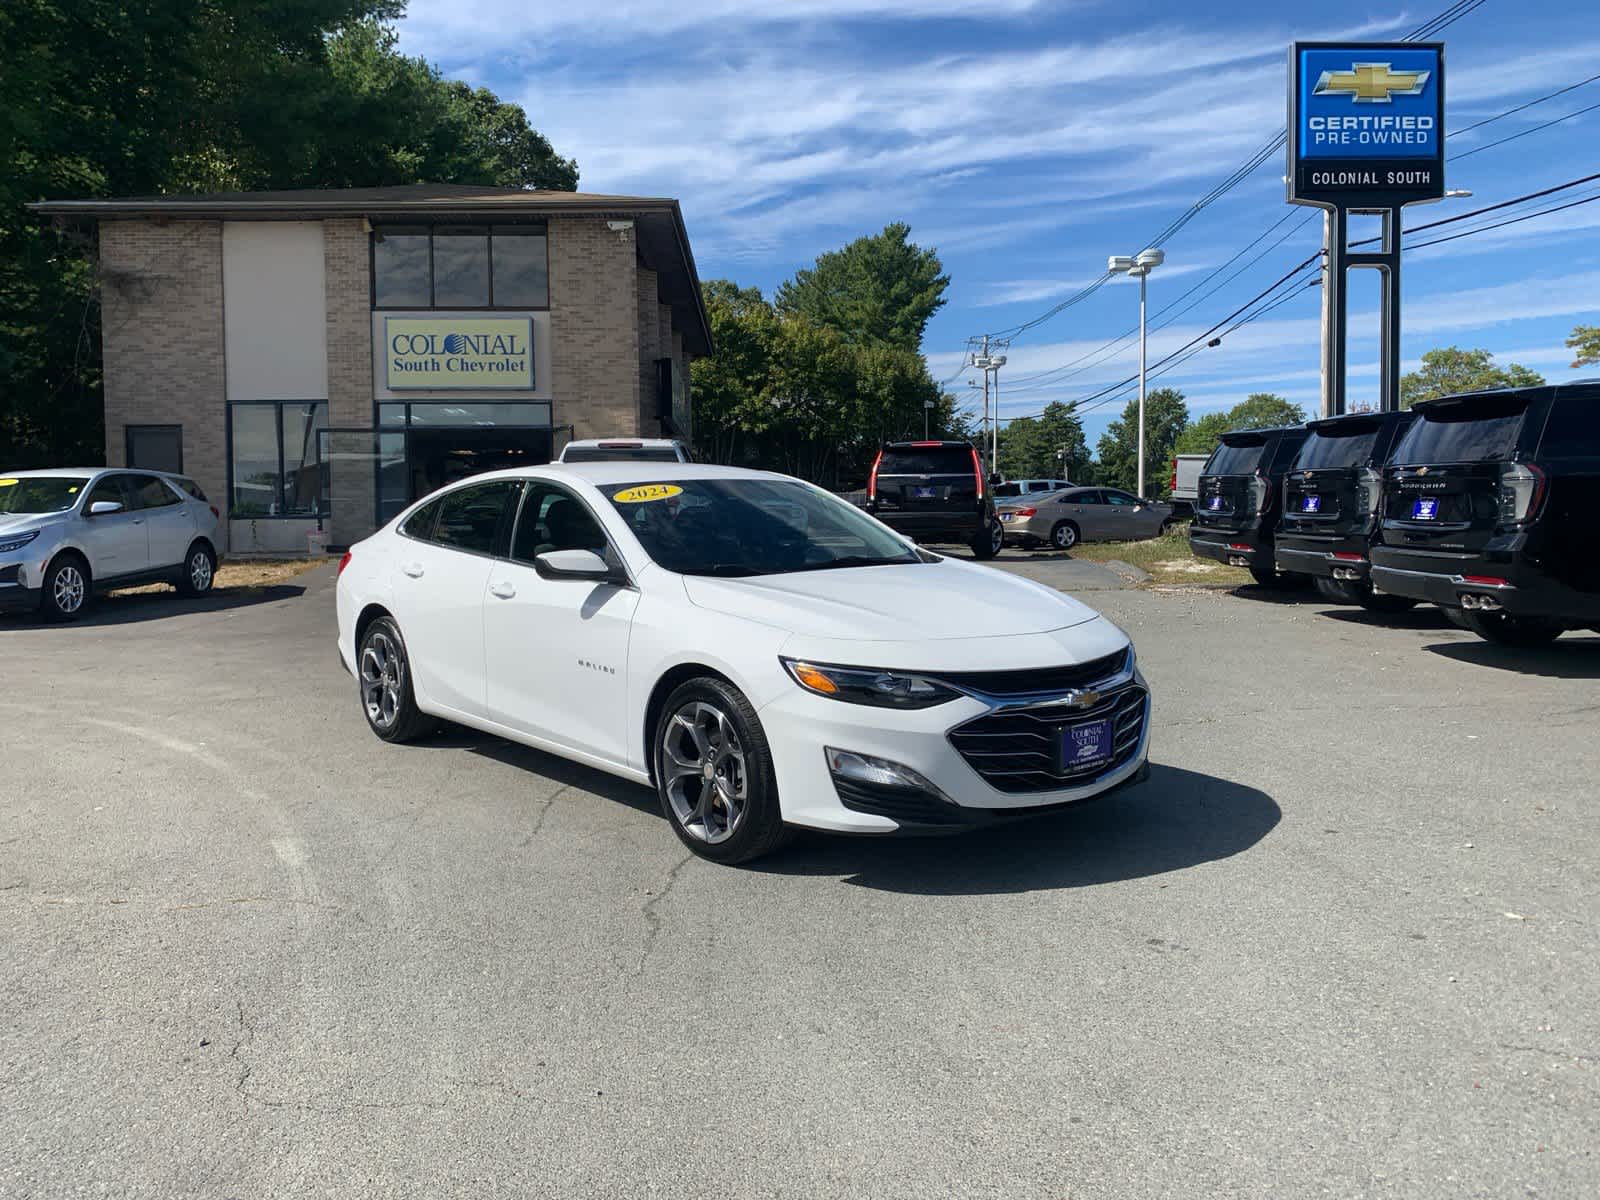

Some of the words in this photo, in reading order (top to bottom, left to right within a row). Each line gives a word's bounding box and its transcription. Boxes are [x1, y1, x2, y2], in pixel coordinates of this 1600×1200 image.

[1309, 116, 1433, 130] CERTIFIED
[1315, 131, 1428, 144] PRE-OWNED
[1312, 172, 1379, 184] COLONIAL
[1387, 171, 1430, 184] SOUTH
[392, 333, 526, 355] COLONIAL
[393, 358, 440, 372] South
[446, 357, 526, 372] Chevrolet
[629, 485, 668, 501] 2024
